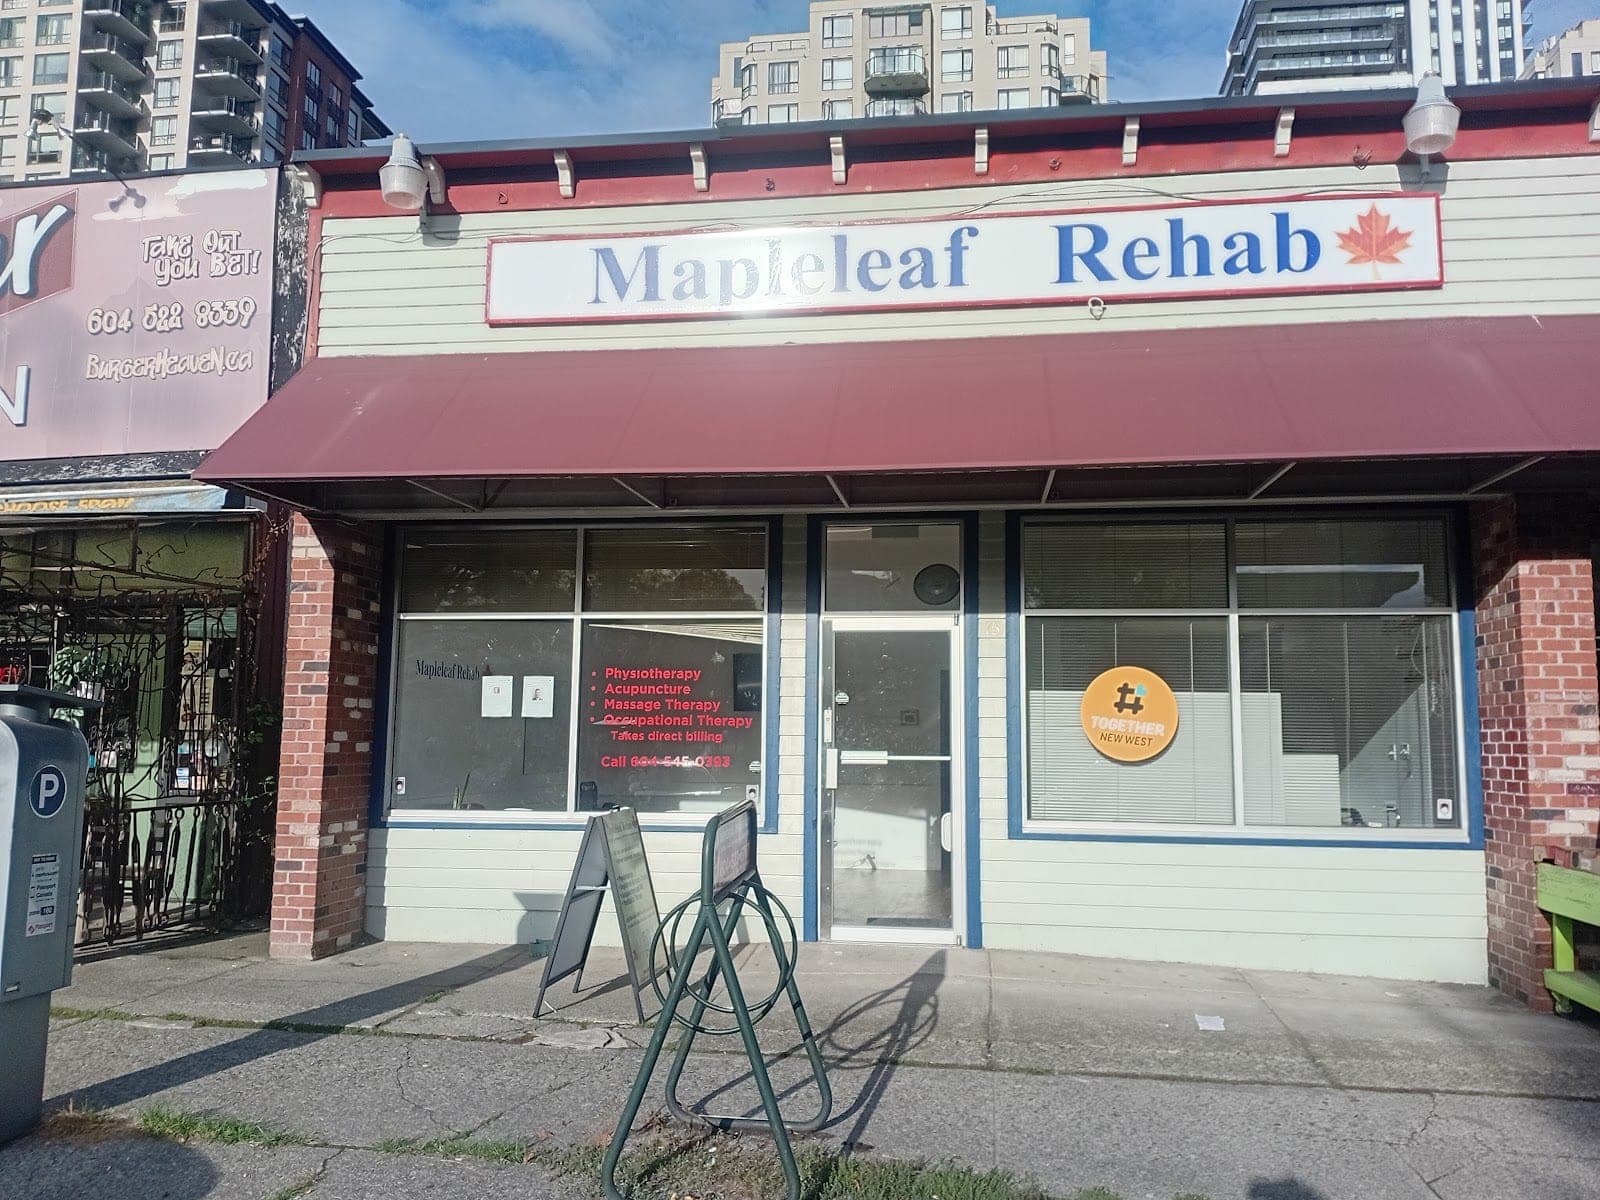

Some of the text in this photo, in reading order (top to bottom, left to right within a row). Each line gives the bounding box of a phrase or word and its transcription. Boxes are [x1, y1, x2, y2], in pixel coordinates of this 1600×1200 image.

[588, 211, 1321, 306] Mapleleaf Rehab
[87, 296, 257, 335] 604 522 8339
[415, 659, 480, 681] Mapleleaf Rehab
[605, 667, 702, 681] Physiotherapy
[604, 682, 692, 696] Acupuncture
[604, 698, 720, 712] Massage Therapy
[603, 713, 752, 728] Occupational Therapy
[1090, 716, 1165, 736] TOGETHER
[611, 730, 723, 743] Takes direct billing
[1099, 732, 1153, 747] NEW WEST
[601, 755, 627, 768] Call
[38, 773, 60, 809] P
